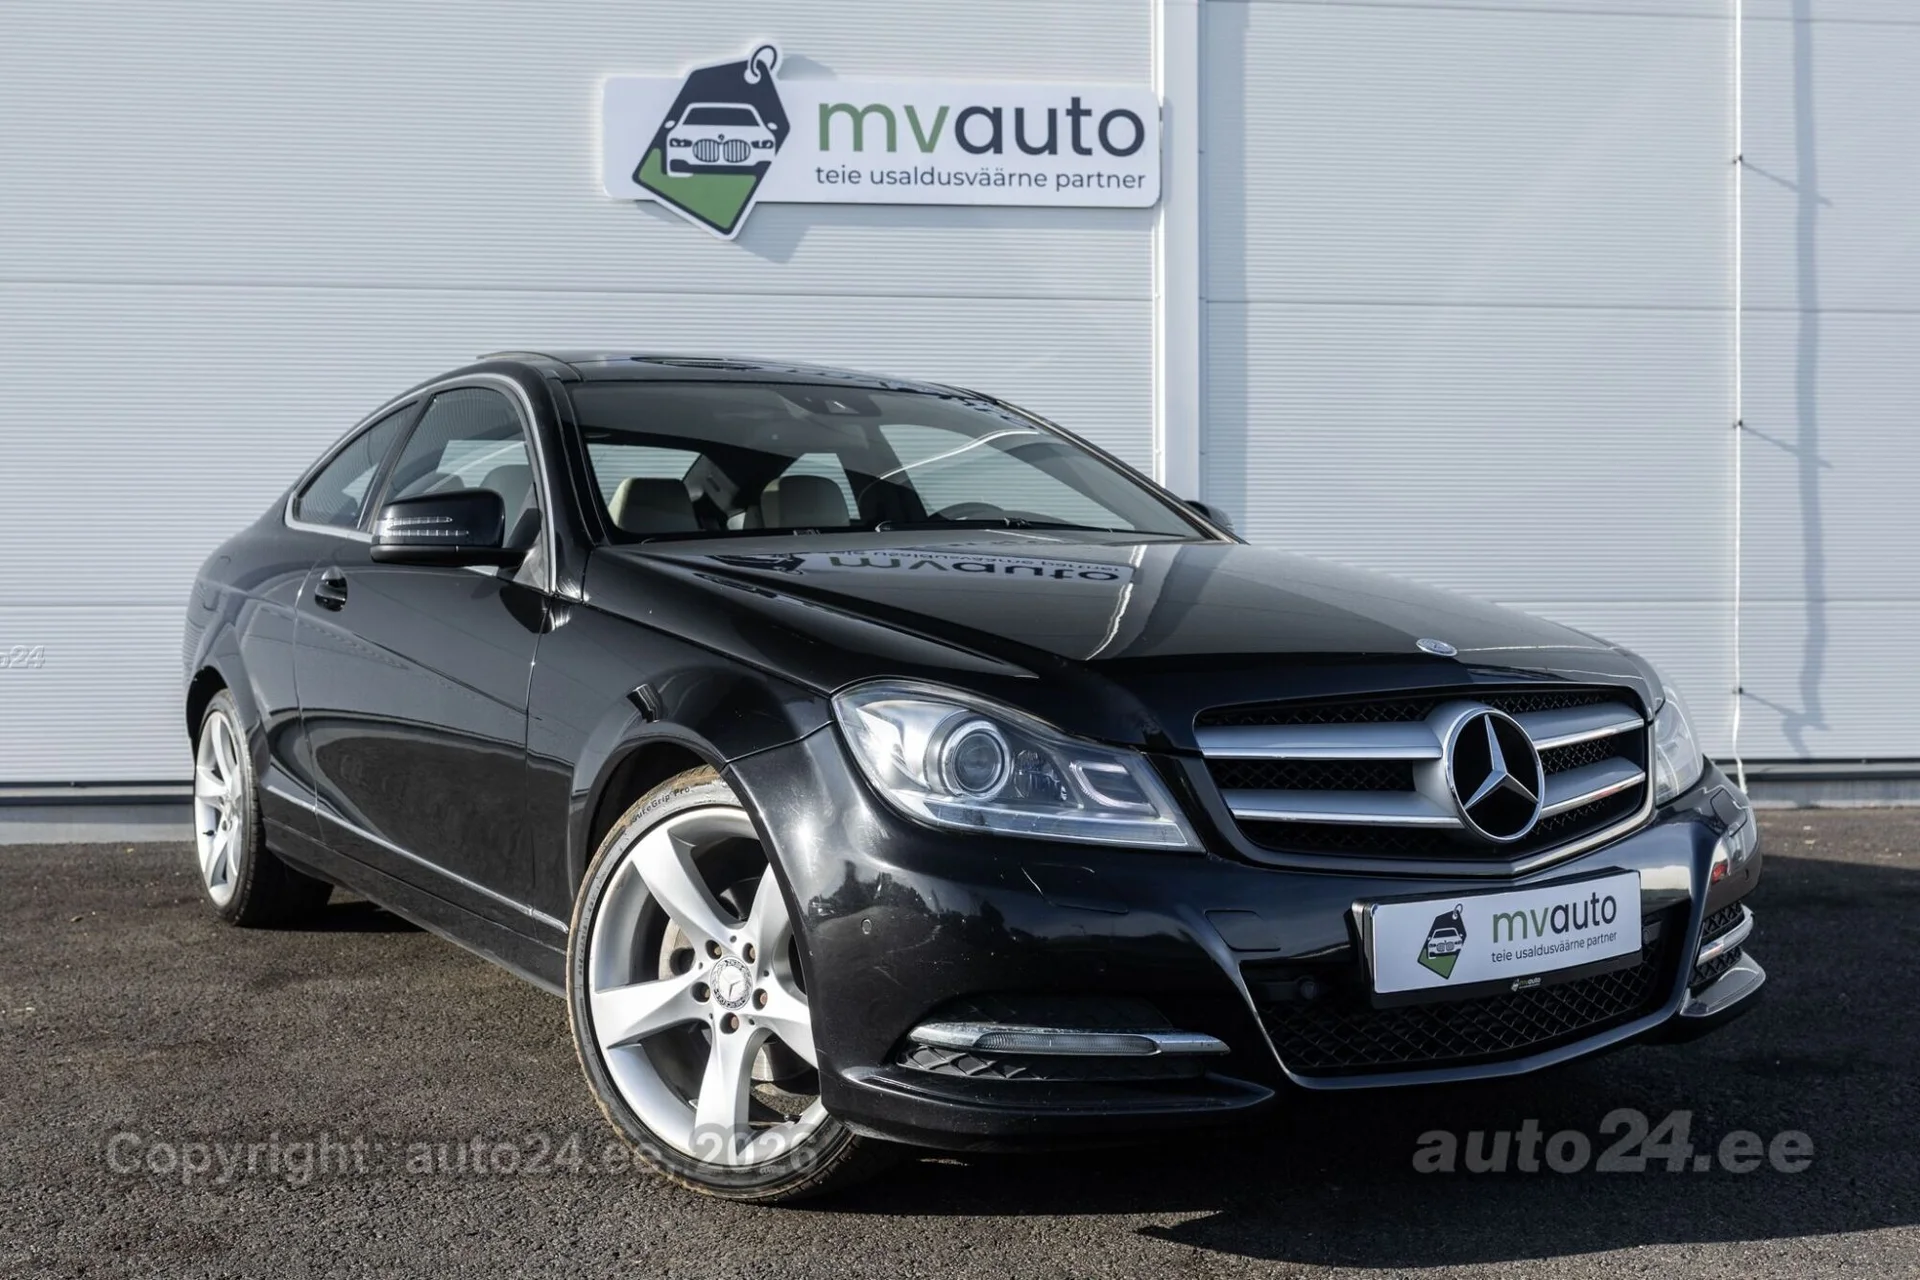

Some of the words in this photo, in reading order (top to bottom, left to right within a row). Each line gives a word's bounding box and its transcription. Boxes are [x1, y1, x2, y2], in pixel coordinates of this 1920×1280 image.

[818, 97, 1146, 157] mvauto
[816, 164, 862, 185] teie
[870, 166, 1048, 190] usaldusväärne
[1055, 170, 1146, 192] partner
[1492, 892, 1617, 943] mvauto
[1491, 947, 1513, 963] teie
[1516, 940, 1584, 959] usaldusväärne
[1587, 931, 1617, 948] partner
